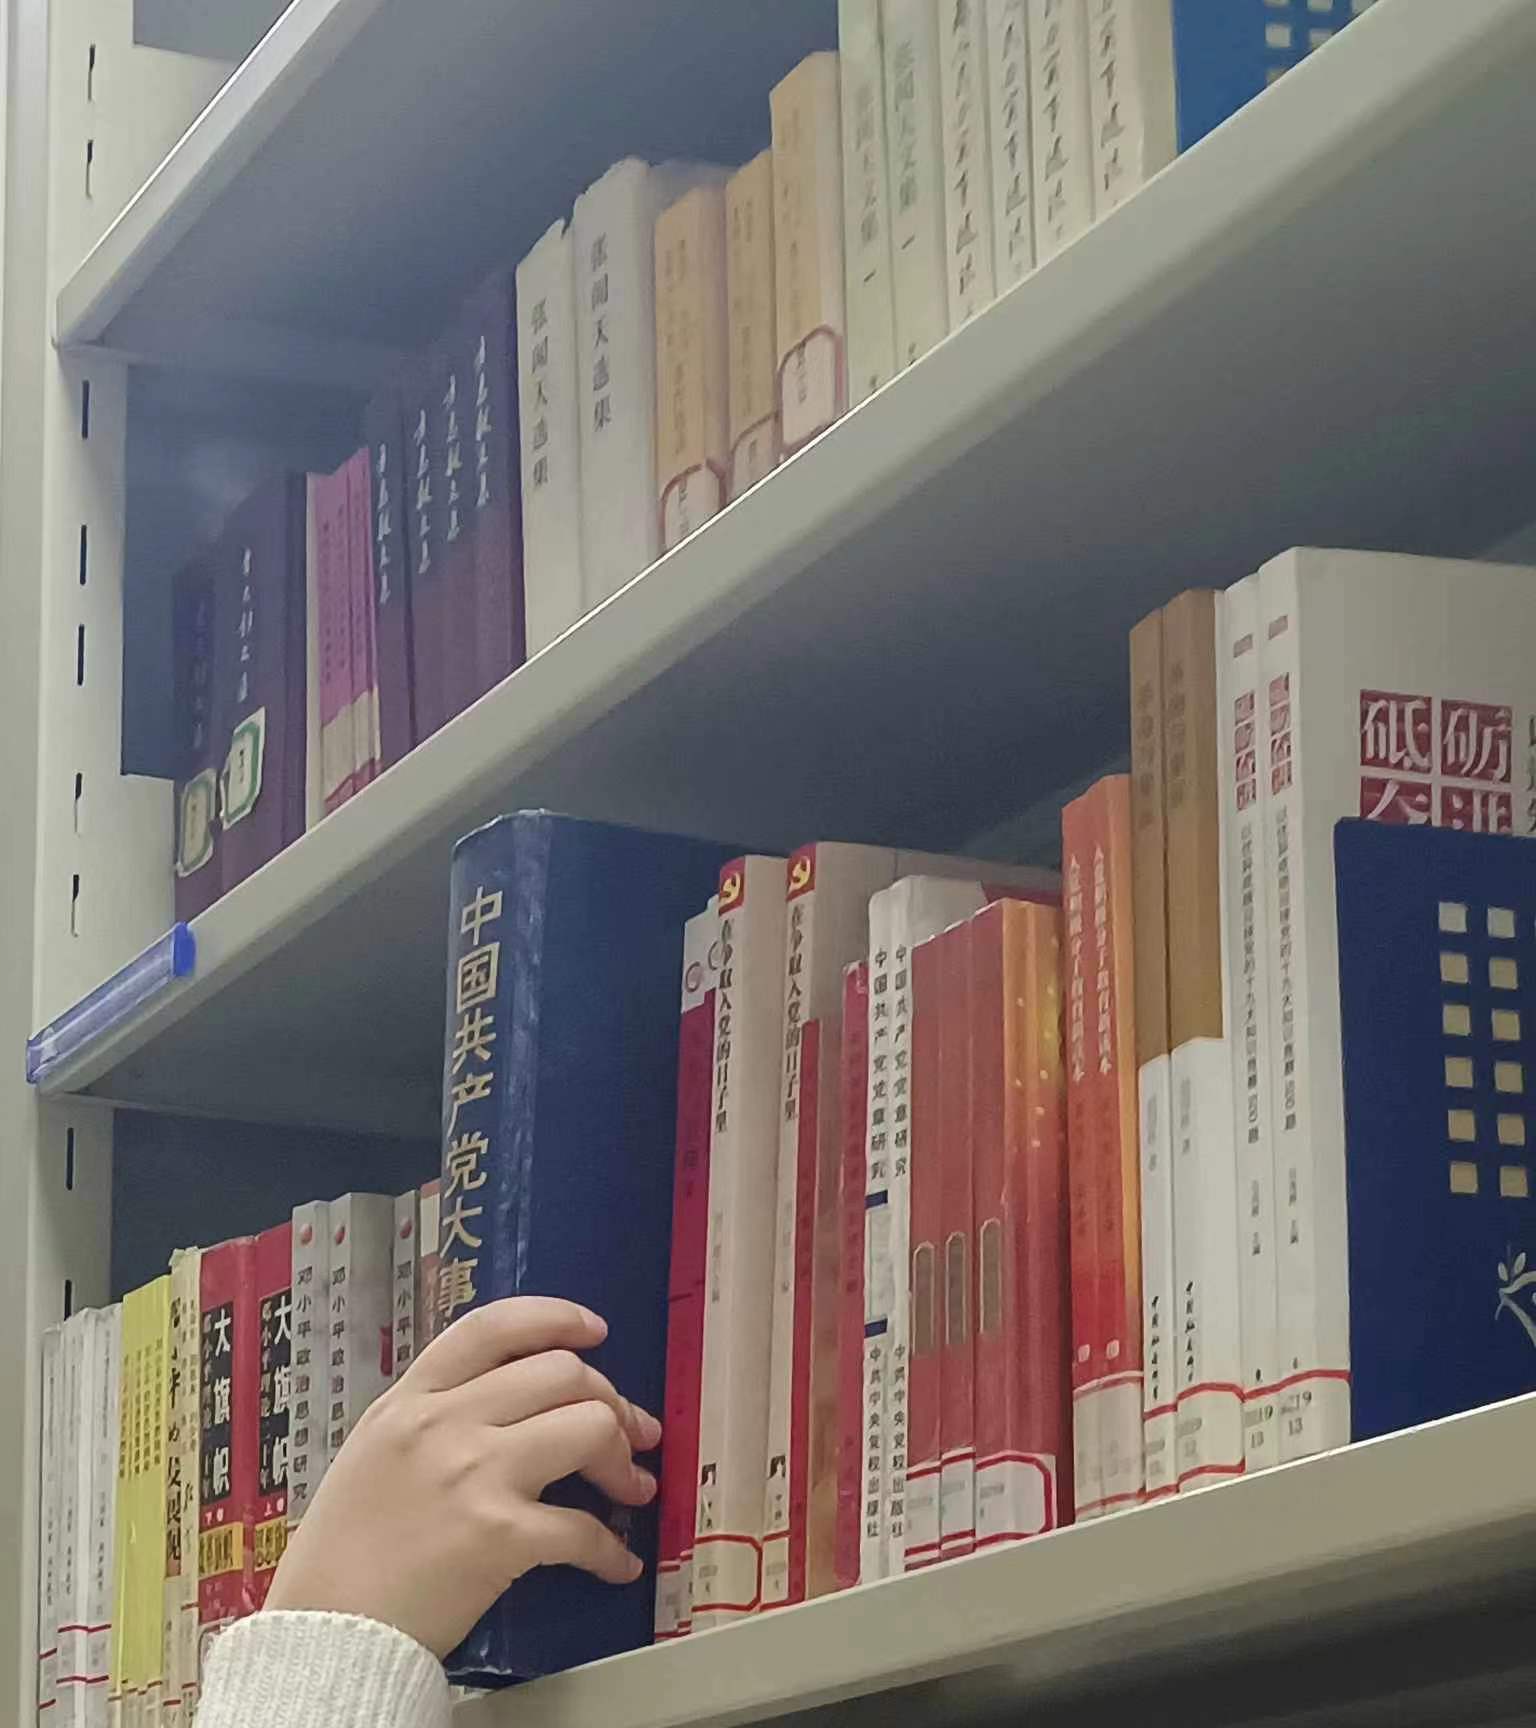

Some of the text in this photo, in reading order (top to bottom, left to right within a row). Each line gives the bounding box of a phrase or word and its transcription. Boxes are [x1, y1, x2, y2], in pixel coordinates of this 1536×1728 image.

[438, 886, 504, 1330] 中国共产党大事
